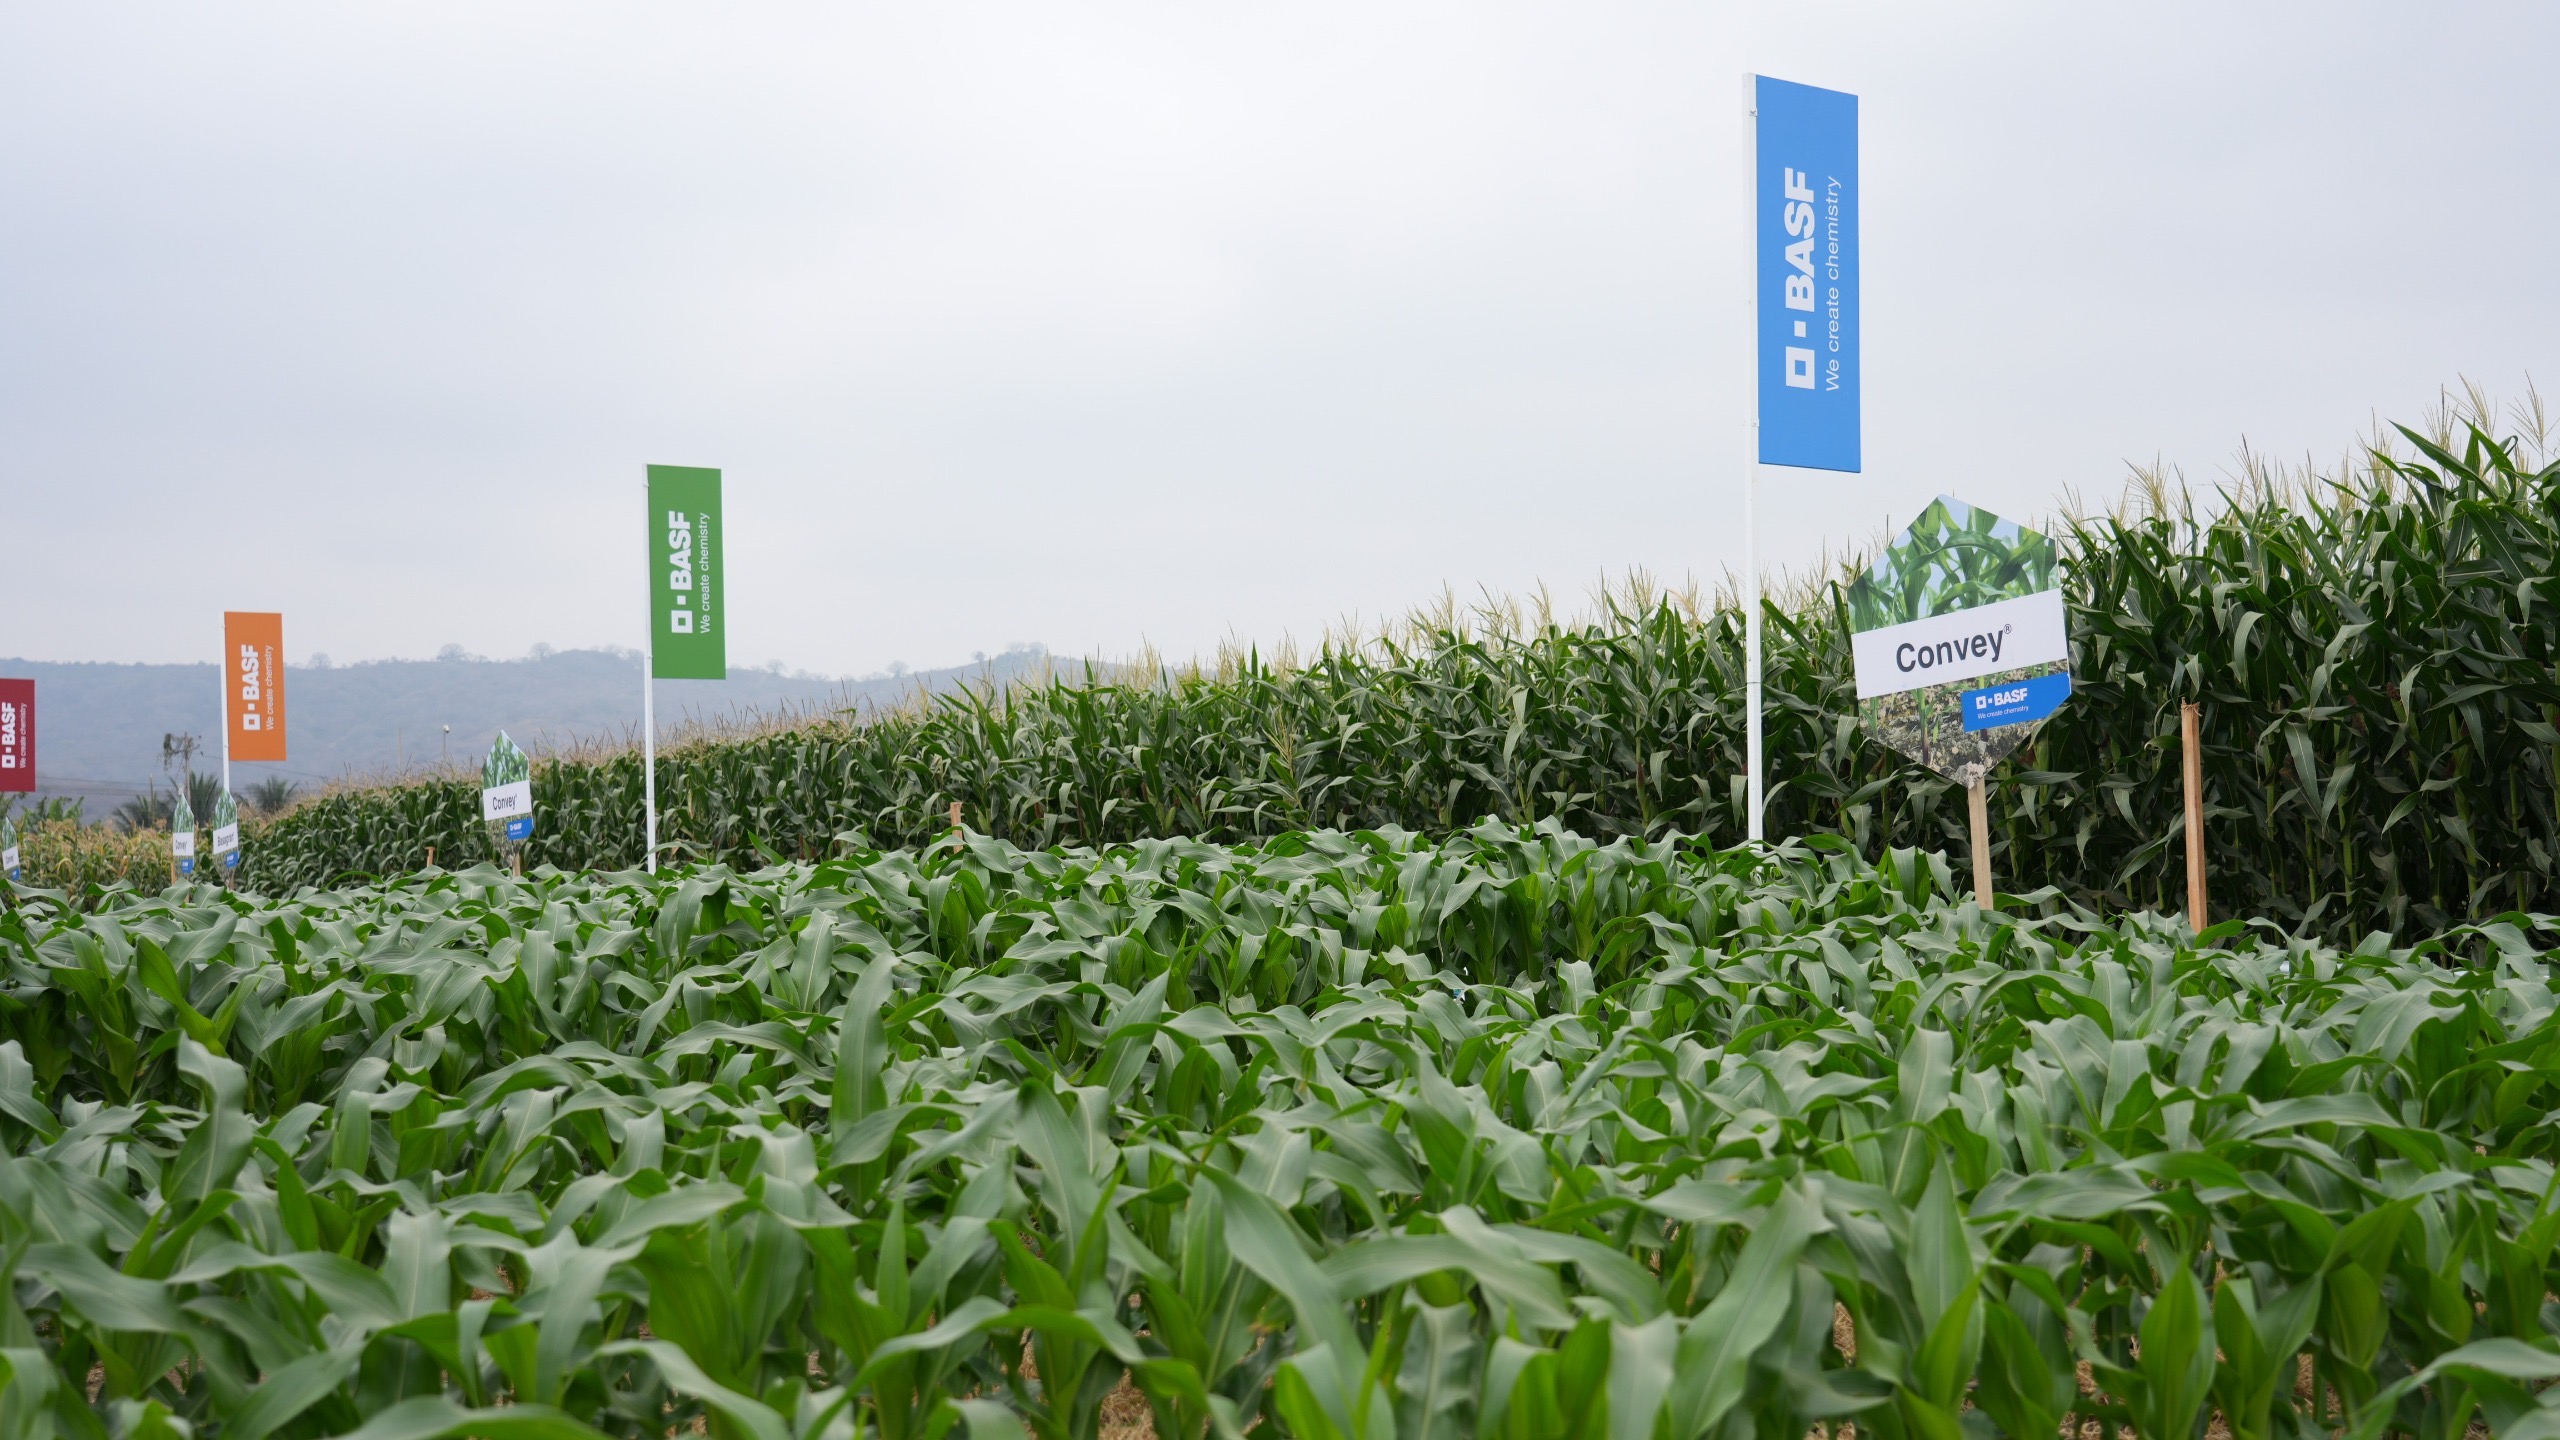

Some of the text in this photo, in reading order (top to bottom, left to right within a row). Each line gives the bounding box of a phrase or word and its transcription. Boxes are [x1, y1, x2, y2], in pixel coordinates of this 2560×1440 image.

[1784, 167, 1816, 312] BASF
[1825, 175, 1842, 392] We create chemistry
[668, 510, 693, 591] BASF
[698, 512, 711, 634] We create chemistry
[240, 643, 260, 700] BASF
[265, 645, 274, 731] We create chemistry
[1993, 687, 2028, 706] BASF
[1, 701, 16, 746] BASF
[1977, 705, 2029, 720] We create chemistry
